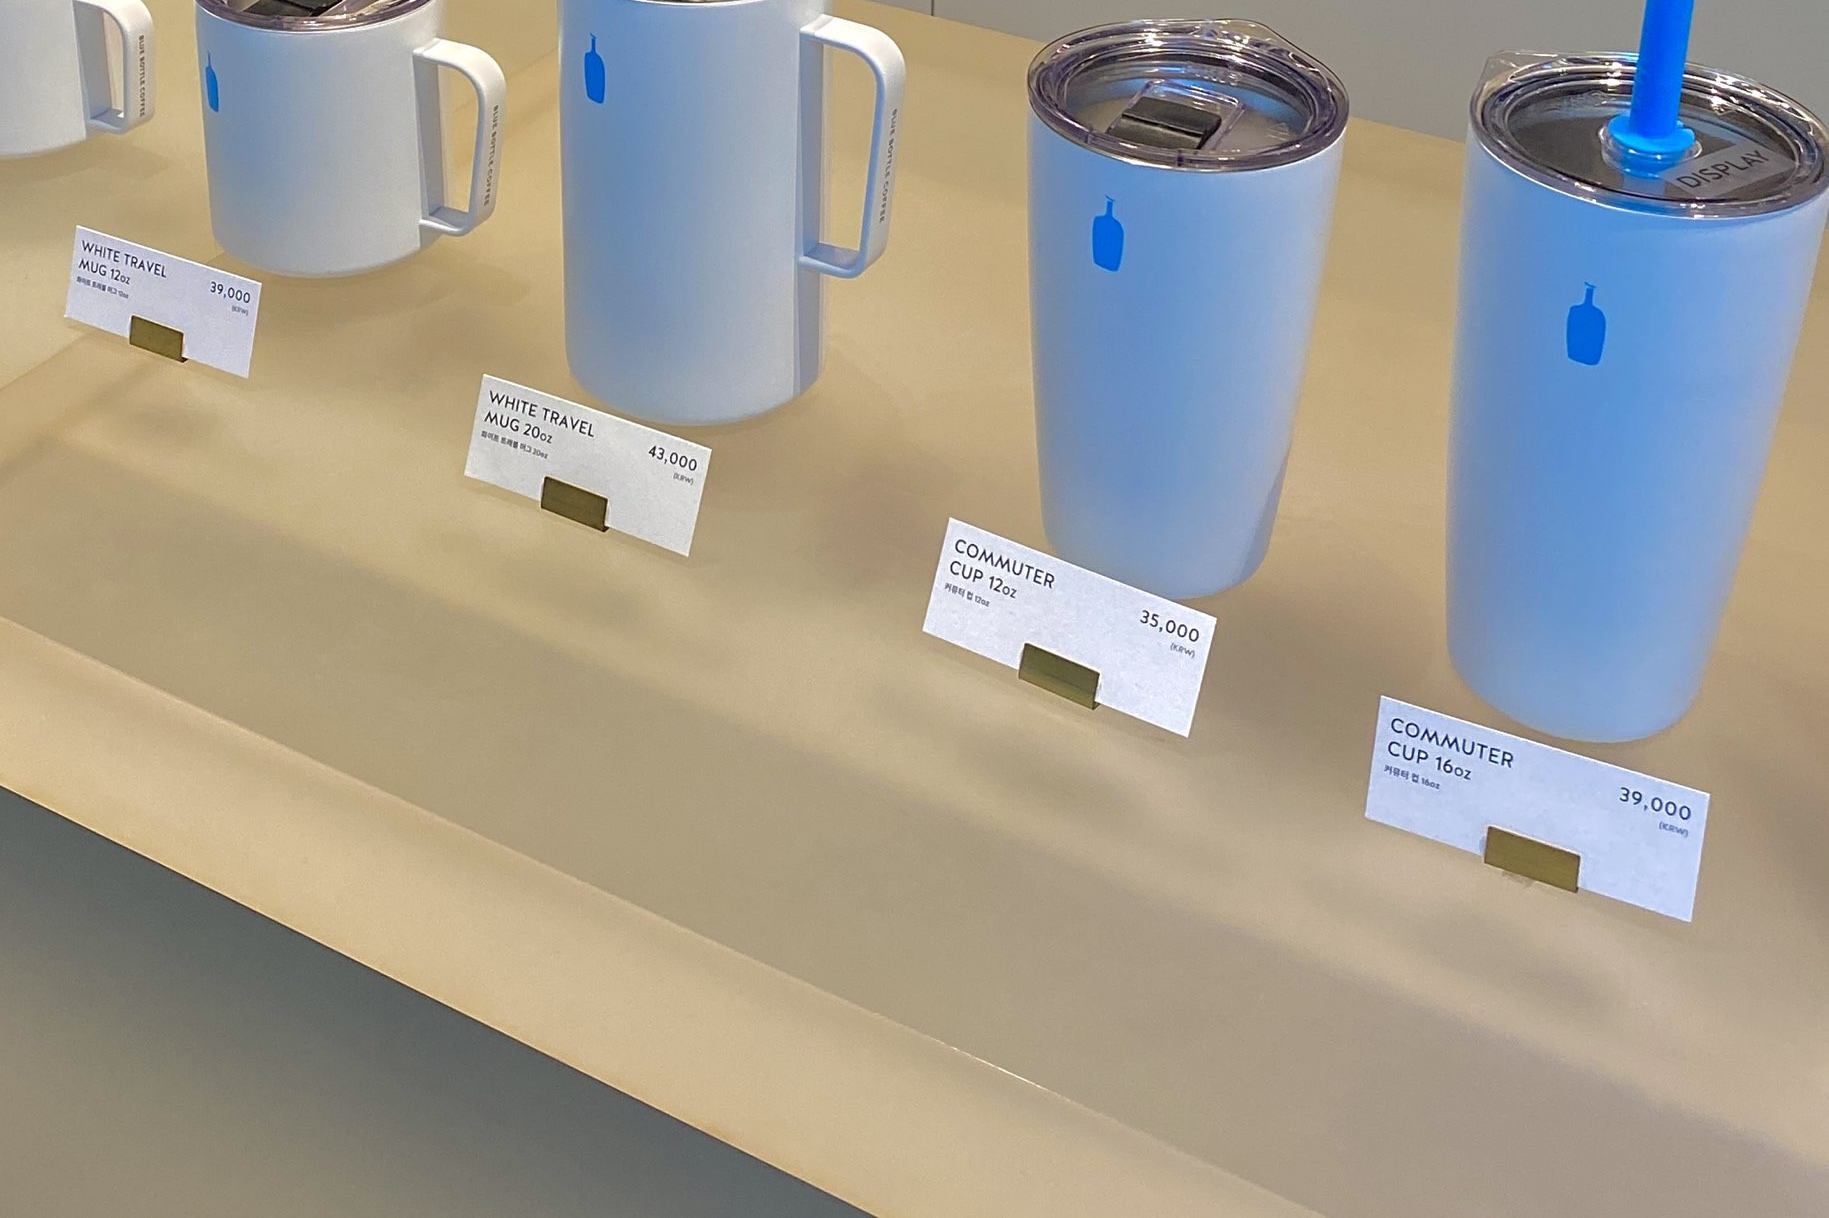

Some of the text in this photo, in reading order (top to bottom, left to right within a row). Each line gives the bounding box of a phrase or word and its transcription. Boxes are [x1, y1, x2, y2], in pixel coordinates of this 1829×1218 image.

[488, 131, 497, 166] BOTTLE
[879, 108, 898, 224] BLUE BOTTLE COFFEE
[1676, 150, 1769, 188] DISPLAY
[483, 168, 493, 207] COFFEE
[78, 259, 131, 285] MUG 12oz
[82, 240, 167, 278] WHITE TRAVEL
[210, 281, 251, 303] 39,000
[484, 411, 553, 444] MUG 20oz
[489, 390, 595, 437] WHITE TRAVEL
[648, 445, 698, 472] 43,000
[949, 560, 1017, 599] CUP 12oz
[954, 539, 1056, 589] COMMUTER
[944, 582, 965, 598] 커뮤터
[974, 595, 990, 607] 12oz
[1139, 609, 1200, 643] 35,000
[1169, 642, 1196, 659] (KRW)
[1387, 740, 1472, 781] CUP 16oz
[1390, 717, 1515, 769] COMMUTER
[1383, 764, 1441, 790] 커뮤터 컵 16oz
[1618, 786, 1692, 821] 39,000
[1658, 821, 1689, 838] (KRW)
